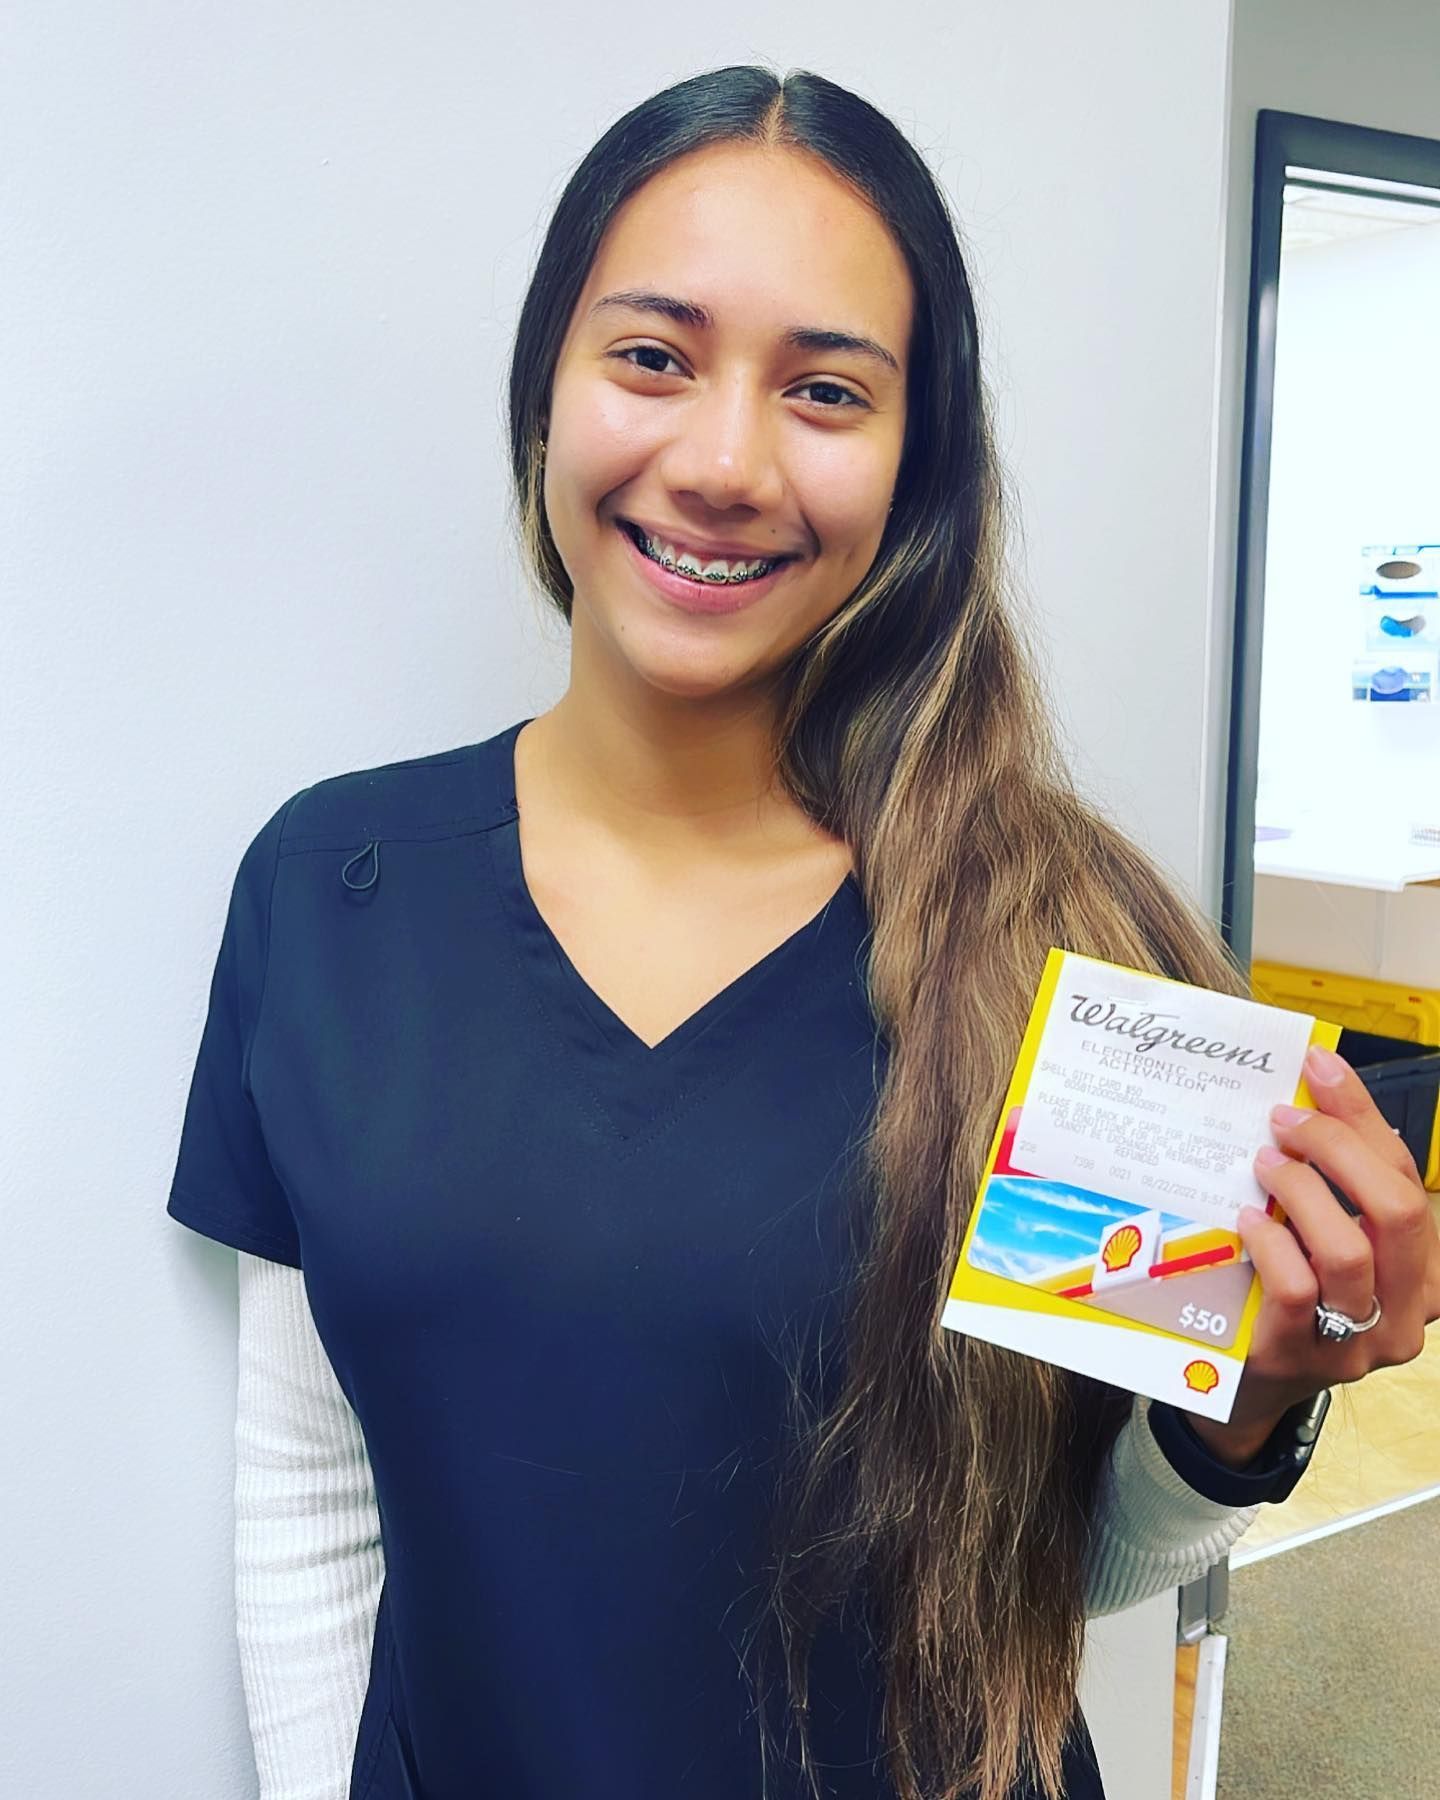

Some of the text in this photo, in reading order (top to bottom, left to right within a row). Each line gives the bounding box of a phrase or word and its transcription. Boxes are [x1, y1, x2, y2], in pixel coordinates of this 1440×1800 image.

[1070, 994, 1276, 1075] Walgreens
[1071, 1069, 1094, 1085] GIFT
[1098, 1076, 1122, 1092] CARD
[1081, 1040, 1242, 1091] ELECTRONIC CARD
[1098, 1056, 1207, 1092] ACTIVATION
[1038, 1091, 1249, 1158] PLEASE SEE BACK OF CARD FOR INFORMATION
[1051, 1107, 1068, 1119] AND
[1072, 1113, 1127, 1135] CONDITIONS
[1130, 1128, 1149, 1141] FOR
[1178, 1142, 1202, 1156] GIFT
[1206, 1149, 1234, 1166] CARDS
[1054, 1118, 1087, 1135] CANNOT
[1090, 1128, 1103, 1140] BE
[1165, 1149, 1211, 1170] RETURNED
[1214, 1163, 1227, 1175] OR
[1201, 1116, 1233, 1133] 50.00
[1179, 1302, 1227, 1336] $50
